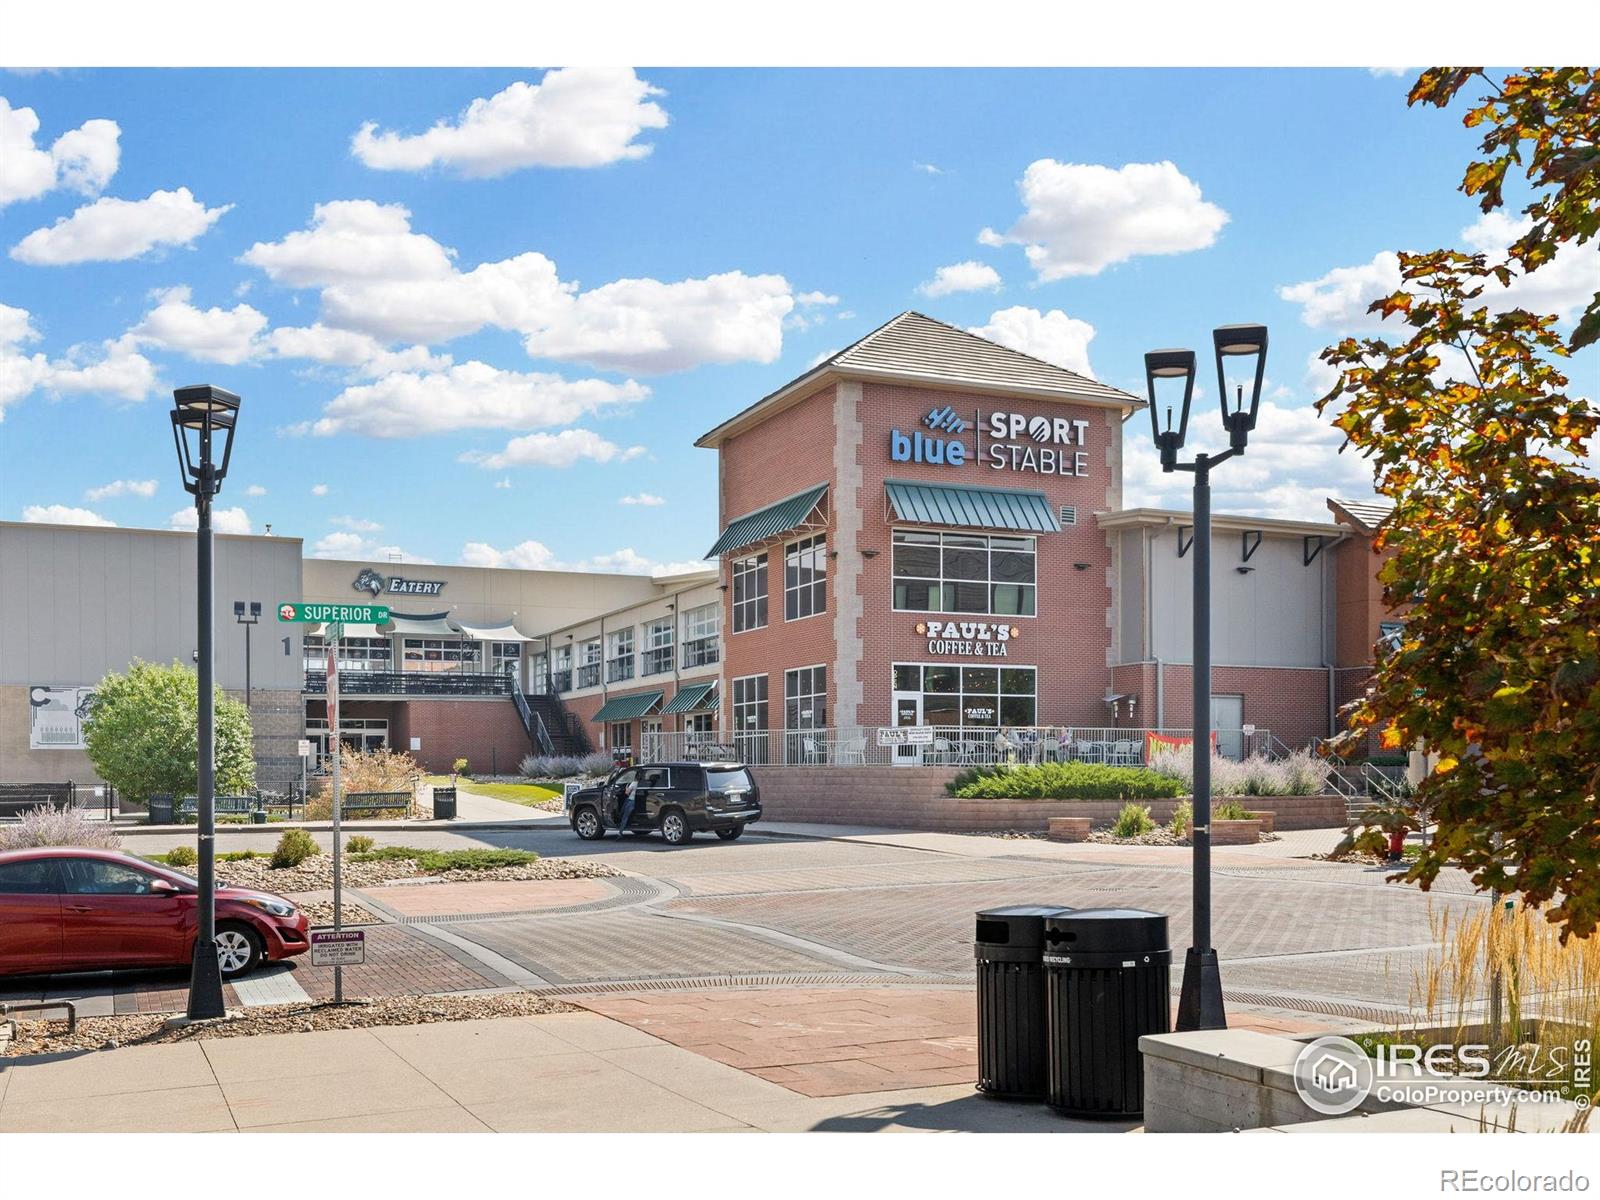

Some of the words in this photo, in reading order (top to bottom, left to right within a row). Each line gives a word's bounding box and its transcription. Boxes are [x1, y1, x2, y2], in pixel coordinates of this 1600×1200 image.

[990, 412, 1089, 446] SPORT
[891, 428, 965, 466] blue
[990, 444, 1089, 477] STABLE
[304, 606, 371, 621] SUPERIOR
[378, 611, 388, 619] DR
[926, 621, 1010, 641] PAUL'S
[281, 636, 291, 656] 1
[928, 640, 972, 656] COFFEE
[974, 641, 983, 656] &
[986, 641, 1007, 657] TEA
